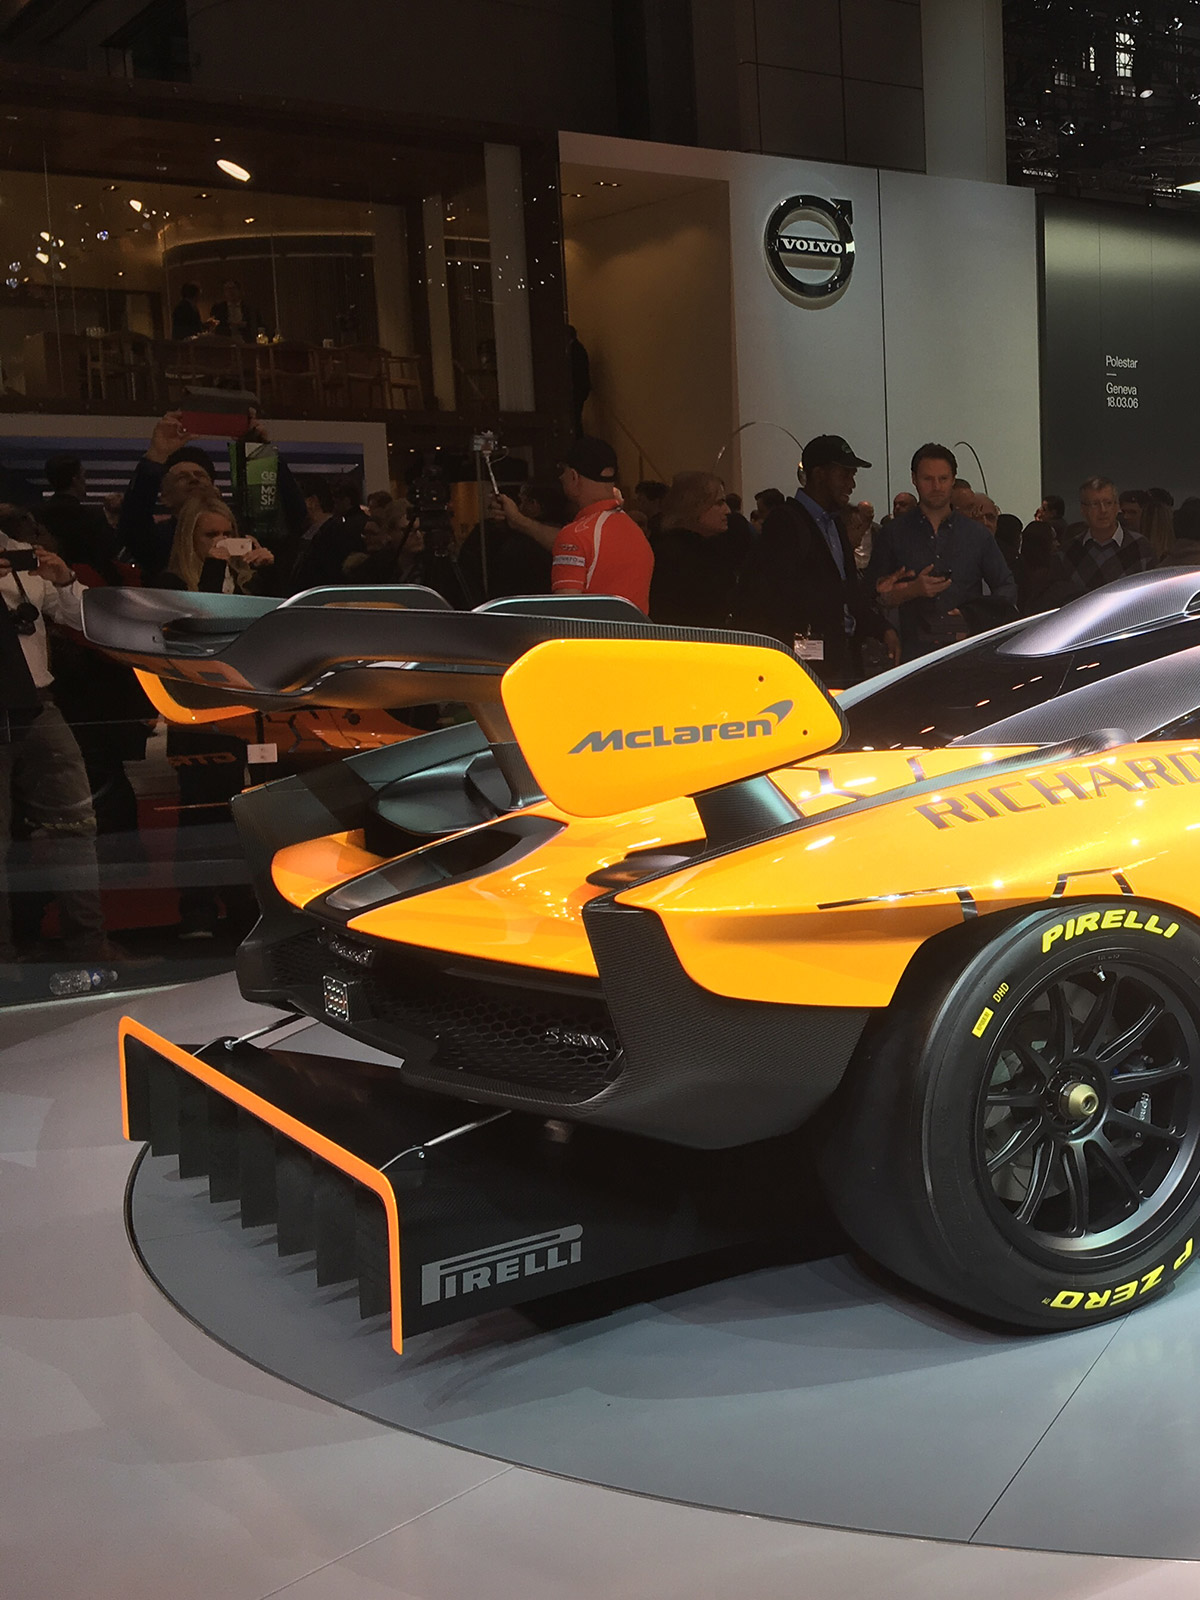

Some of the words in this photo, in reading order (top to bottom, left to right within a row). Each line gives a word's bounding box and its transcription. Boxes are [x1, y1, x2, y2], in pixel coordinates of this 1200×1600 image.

[780, 238, 843, 254] VOLVO
[1105, 354, 1139, 369] Polestar
[1105, 381, 1138, 396] Geneva
[1106, 396, 1139, 409] 18.03.06
[567, 718, 773, 755] McLaren
[1040, 907, 1180, 954] PIRELLI
[992, 981, 1010, 1004] DHD
[421, 1223, 584, 1306] PIRELLI
[1173, 1237, 1194, 1271] P
[1049, 1264, 1166, 1310] ZERO
